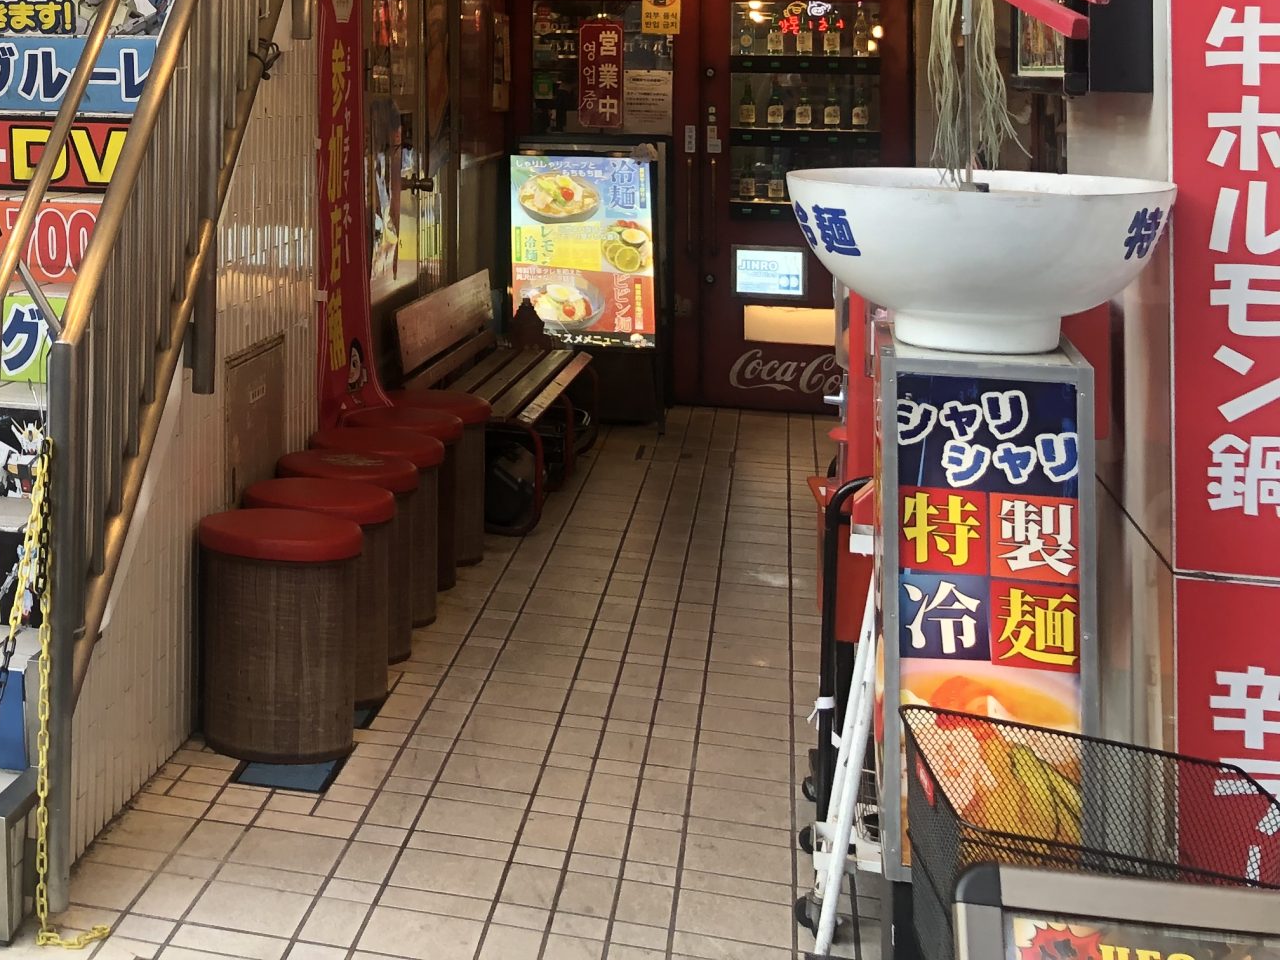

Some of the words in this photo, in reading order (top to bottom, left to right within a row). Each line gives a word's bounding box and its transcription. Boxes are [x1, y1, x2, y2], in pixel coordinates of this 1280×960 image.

[579, 41, 597, 110] 영업중
[598, 30, 619, 122] 営業中
[609, 159, 637, 210] 冷麺
[738, 259, 779, 271] JINRO
[1205, 4, 1280, 517] 牛ホルモン鍋
[897, 389, 1029, 445] シャリ
[940, 433, 1079, 487] シャリ
[903, 493, 1078, 577] 特製
[903, 579, 1078, 667] 冷麺
